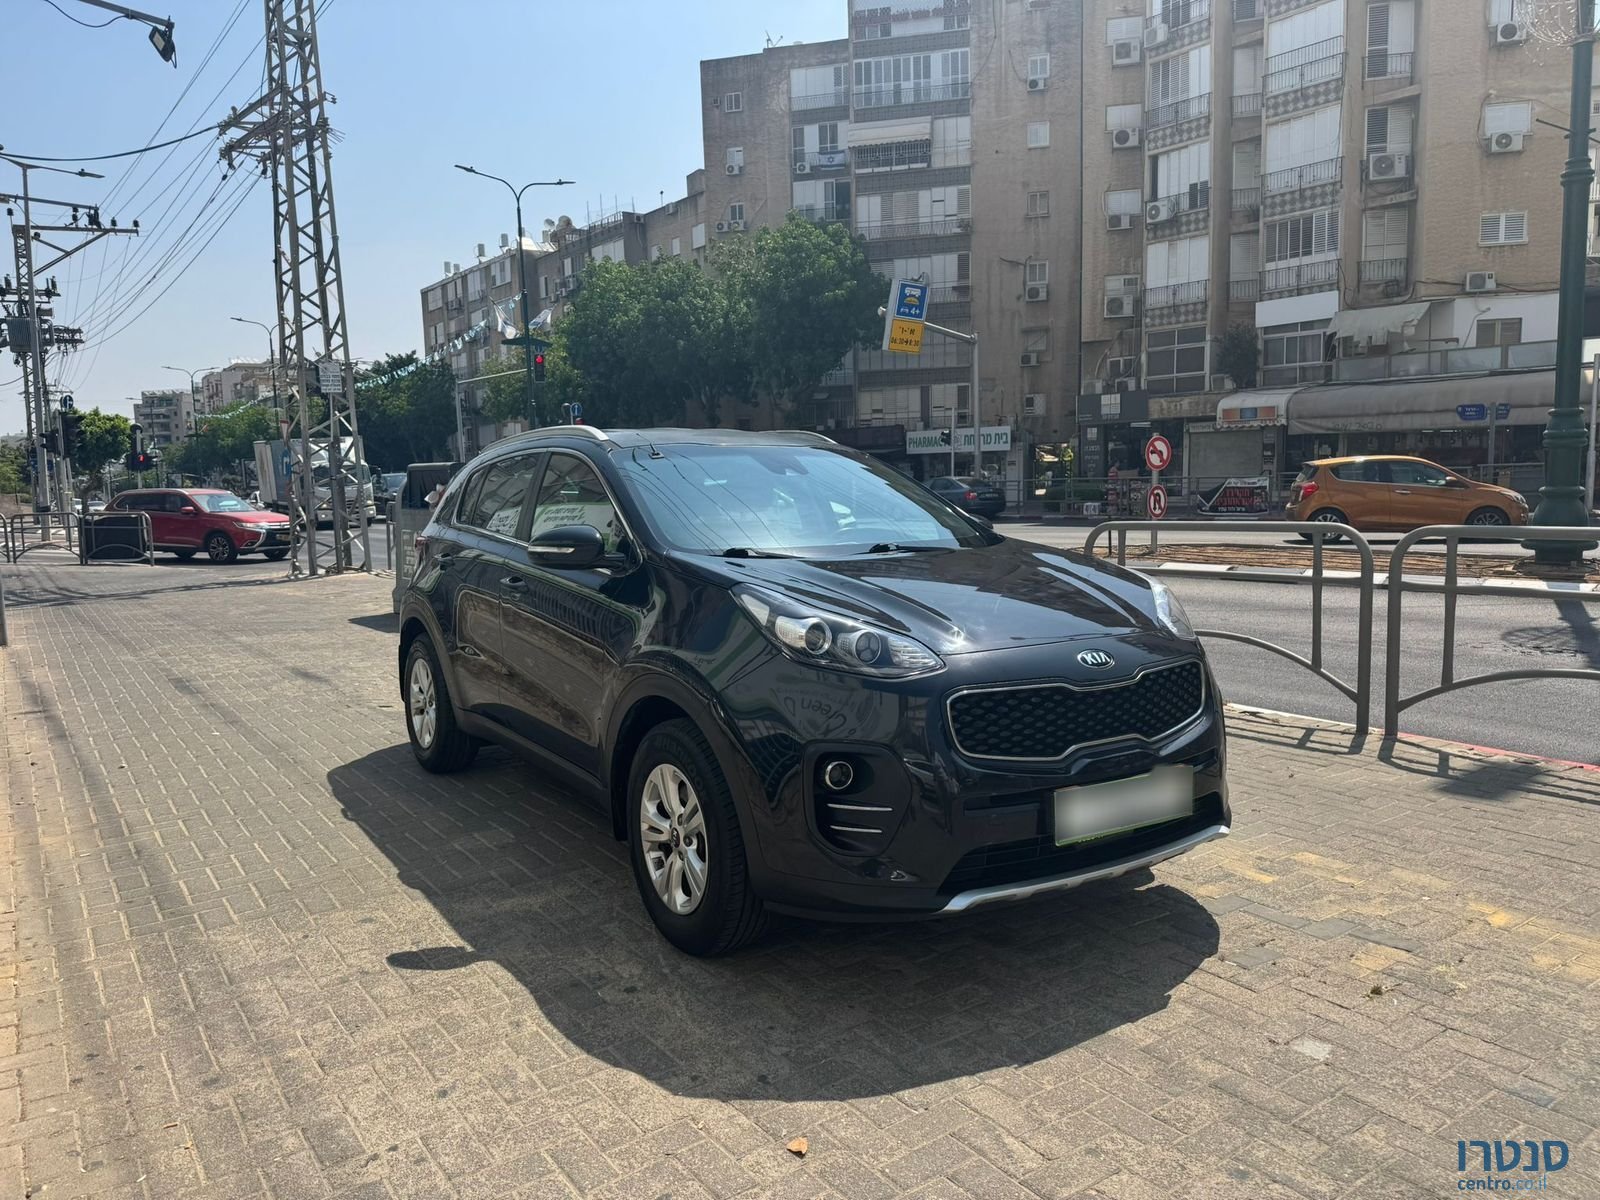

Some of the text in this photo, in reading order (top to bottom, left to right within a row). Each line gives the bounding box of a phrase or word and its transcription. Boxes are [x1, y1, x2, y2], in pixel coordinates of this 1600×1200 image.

[908, 436, 947, 449] PHARMAC
[963, 432, 1009, 446] בית מרחת
[1083, 652, 1111, 665] KIA
